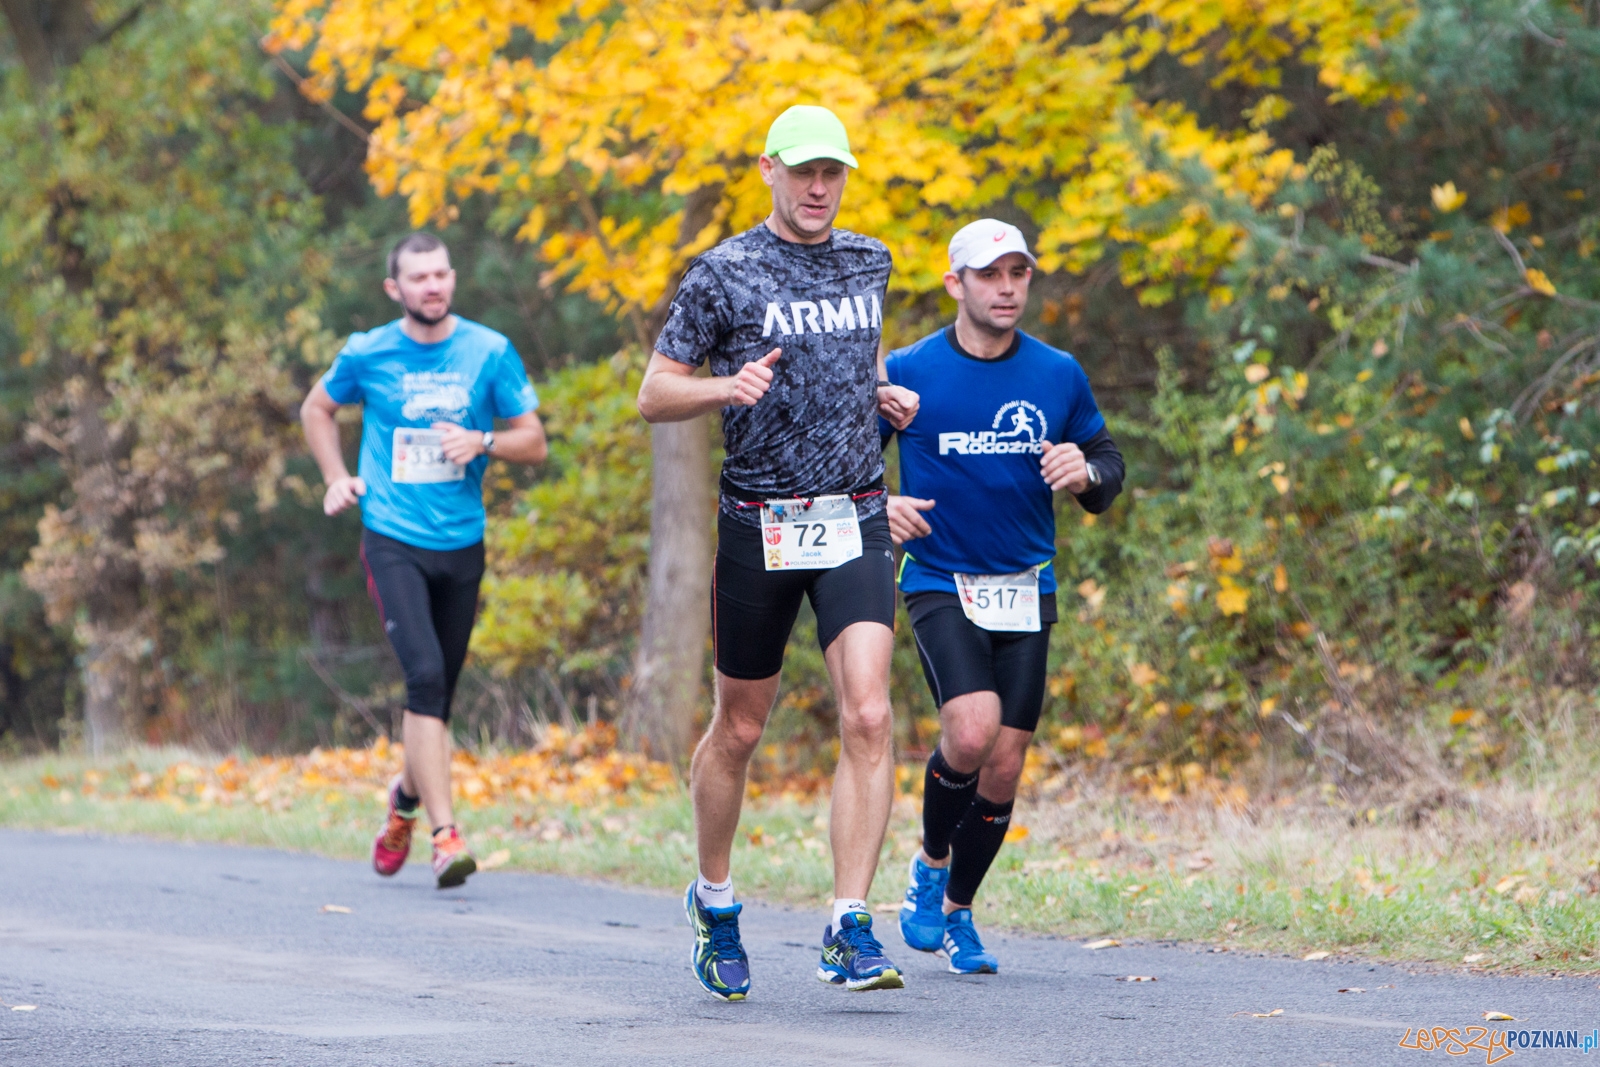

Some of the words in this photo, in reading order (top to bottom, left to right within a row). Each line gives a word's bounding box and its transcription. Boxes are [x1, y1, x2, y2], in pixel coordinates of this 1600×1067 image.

[793, 523, 828, 547] 72
[800, 550, 822, 558] Jacek
[977, 588, 1018, 609] 517
